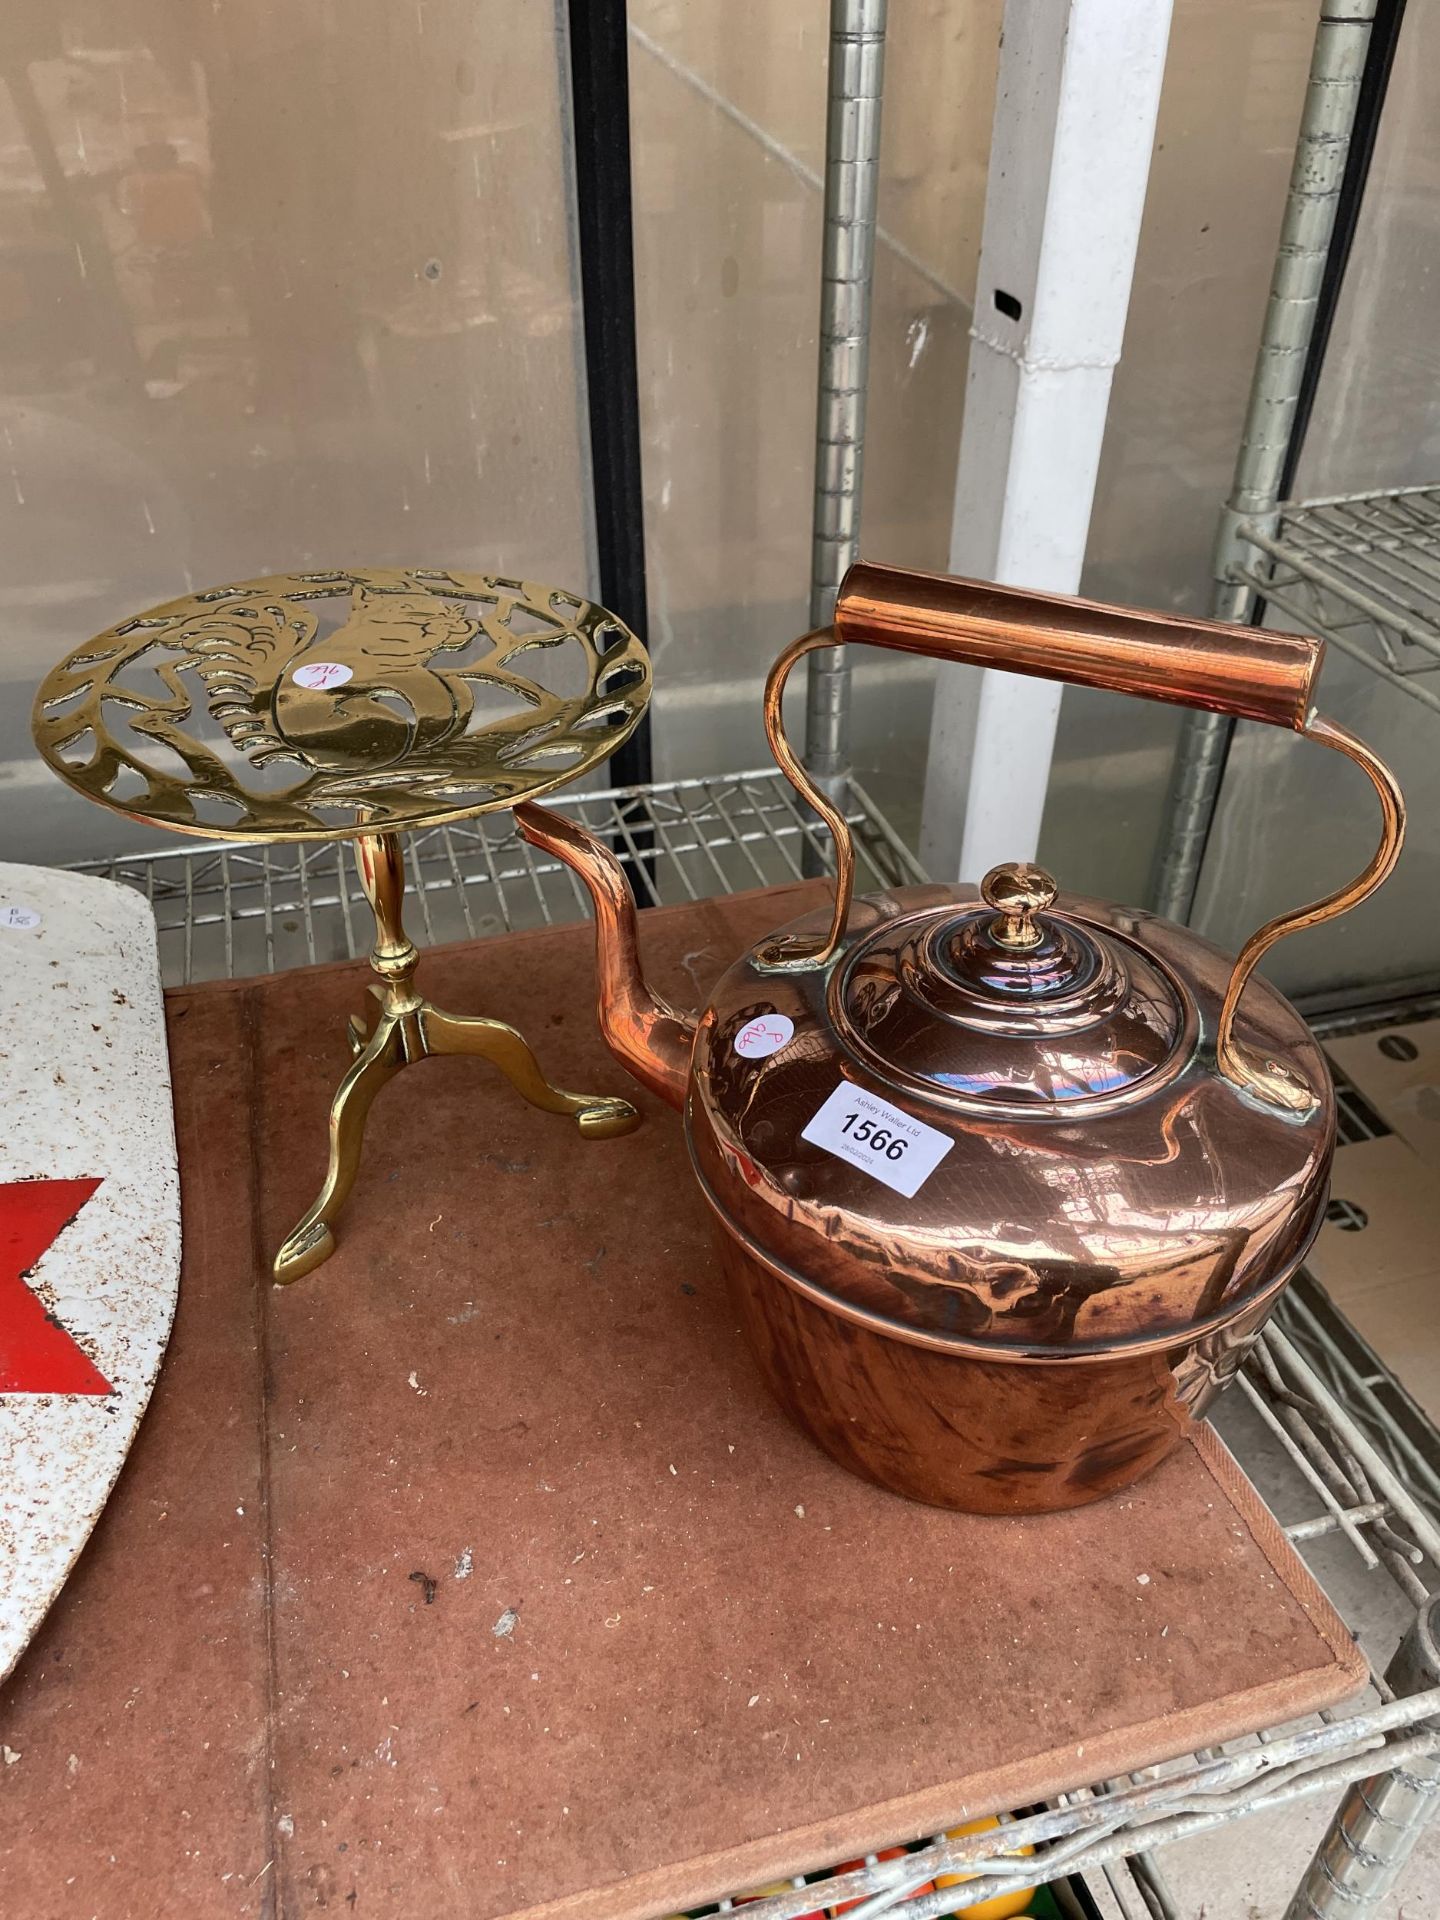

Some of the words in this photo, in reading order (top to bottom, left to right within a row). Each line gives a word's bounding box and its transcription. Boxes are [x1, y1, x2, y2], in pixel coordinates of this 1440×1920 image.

[841, 1113, 909, 1161] 1566
[854, 1096, 881, 1115] Ashley
[880, 1111, 907, 1129] Waller
[906, 1125, 922, 1137] Ltd
